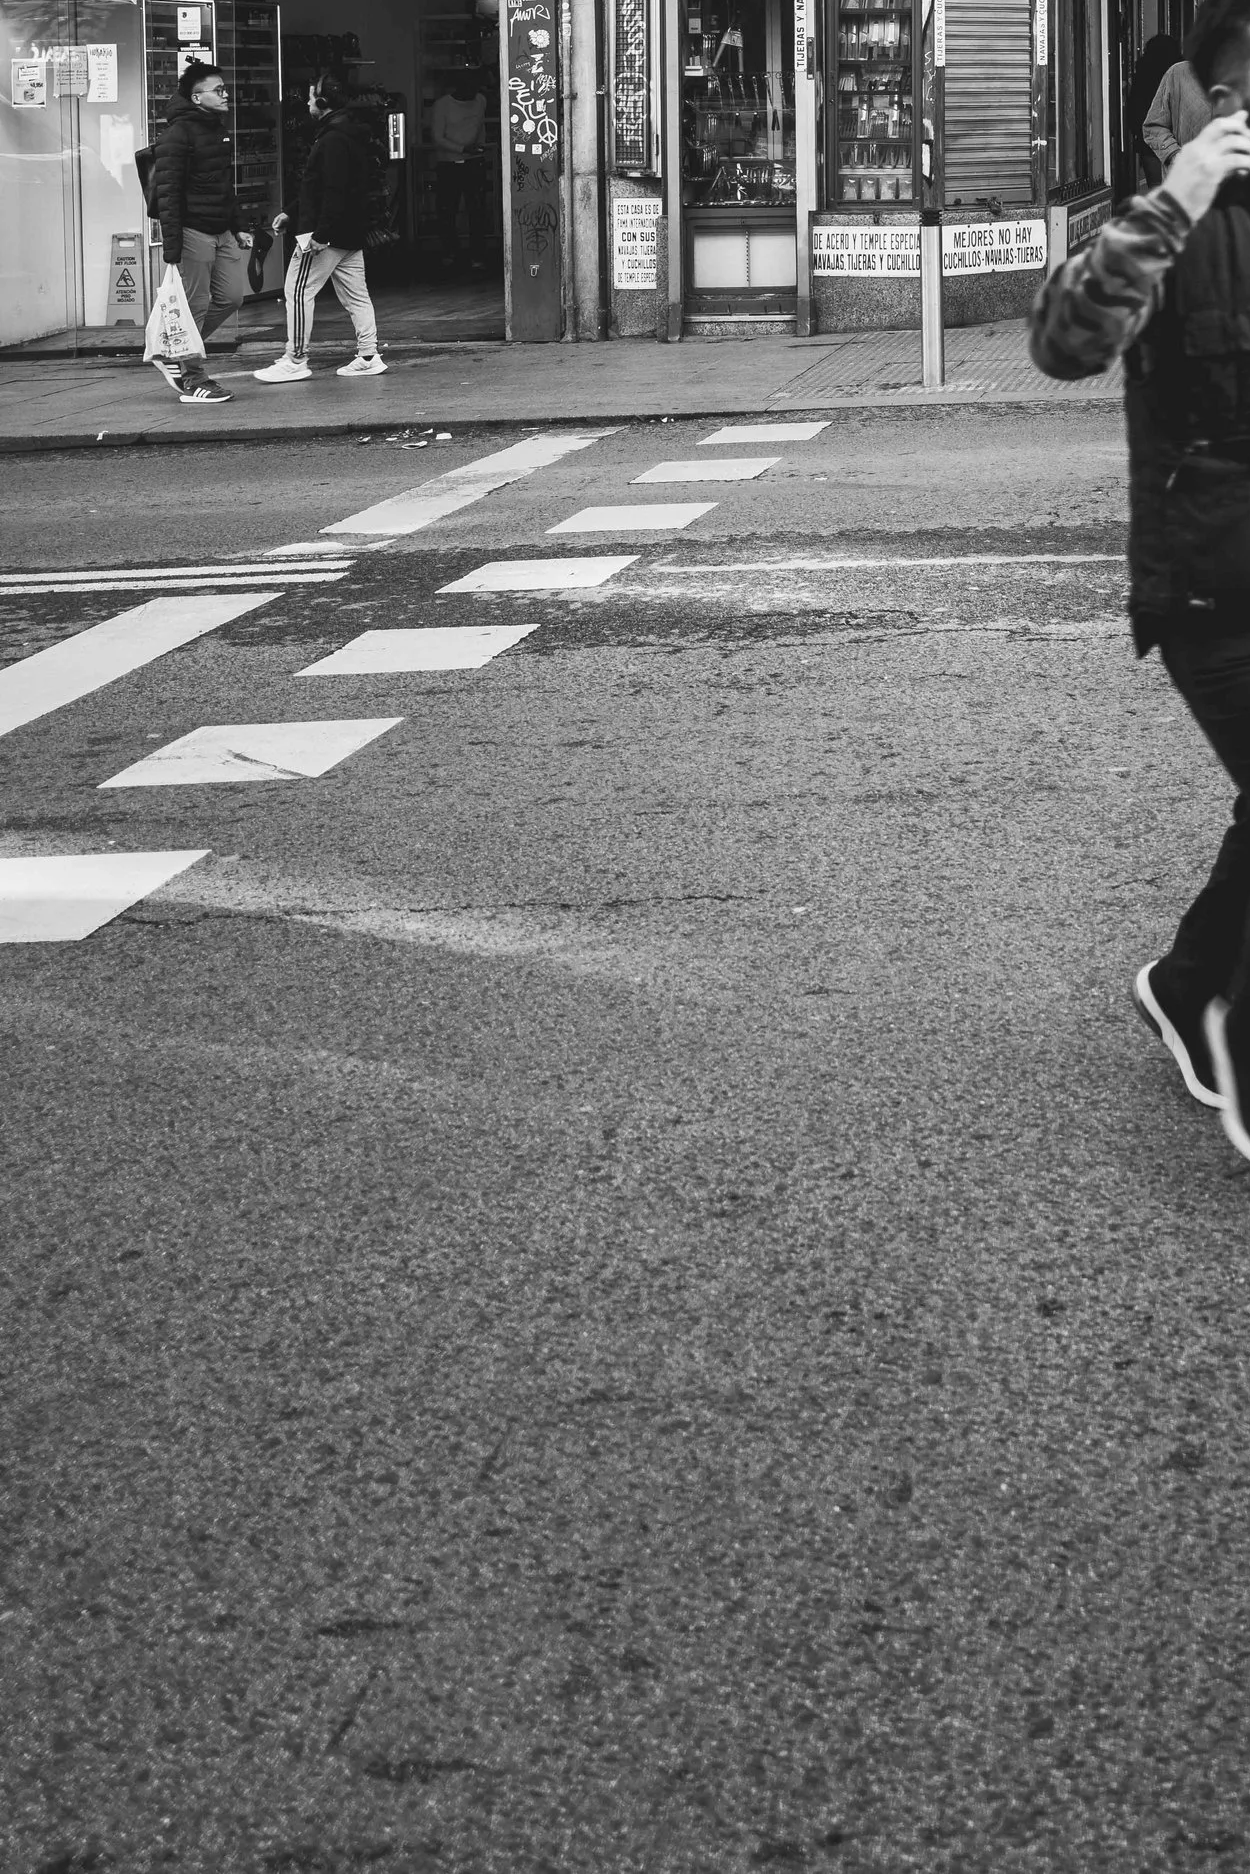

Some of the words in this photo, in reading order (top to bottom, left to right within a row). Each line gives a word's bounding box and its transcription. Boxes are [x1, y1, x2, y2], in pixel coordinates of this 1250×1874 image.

[796, 26, 805, 68] TIJERAS
[617, 204, 629, 215] ESTA
[630, 204, 643, 215] CASA
[644, 204, 652, 215] ES
[652, 204, 660, 215] DE
[621, 231, 637, 242] CON
[640, 231, 656, 242] SUS
[813, 233, 823, 250] DE
[827, 233, 849, 250] ACERO
[852, 233, 857, 250] Y
[860, 233, 887, 250] TEMPLE
[890, 233, 920, 250] ESPECIA
[953, 229, 994, 249] MEJORES
[998, 228, 1011, 245] NO
[1015, 227, 1032, 244] HAY
[640, 245, 656, 255] TIJERA
[847, 254, 876, 271] TIJERAS
[879, 254, 884, 271] Y
[887, 254, 920, 271] CUCHILLO
